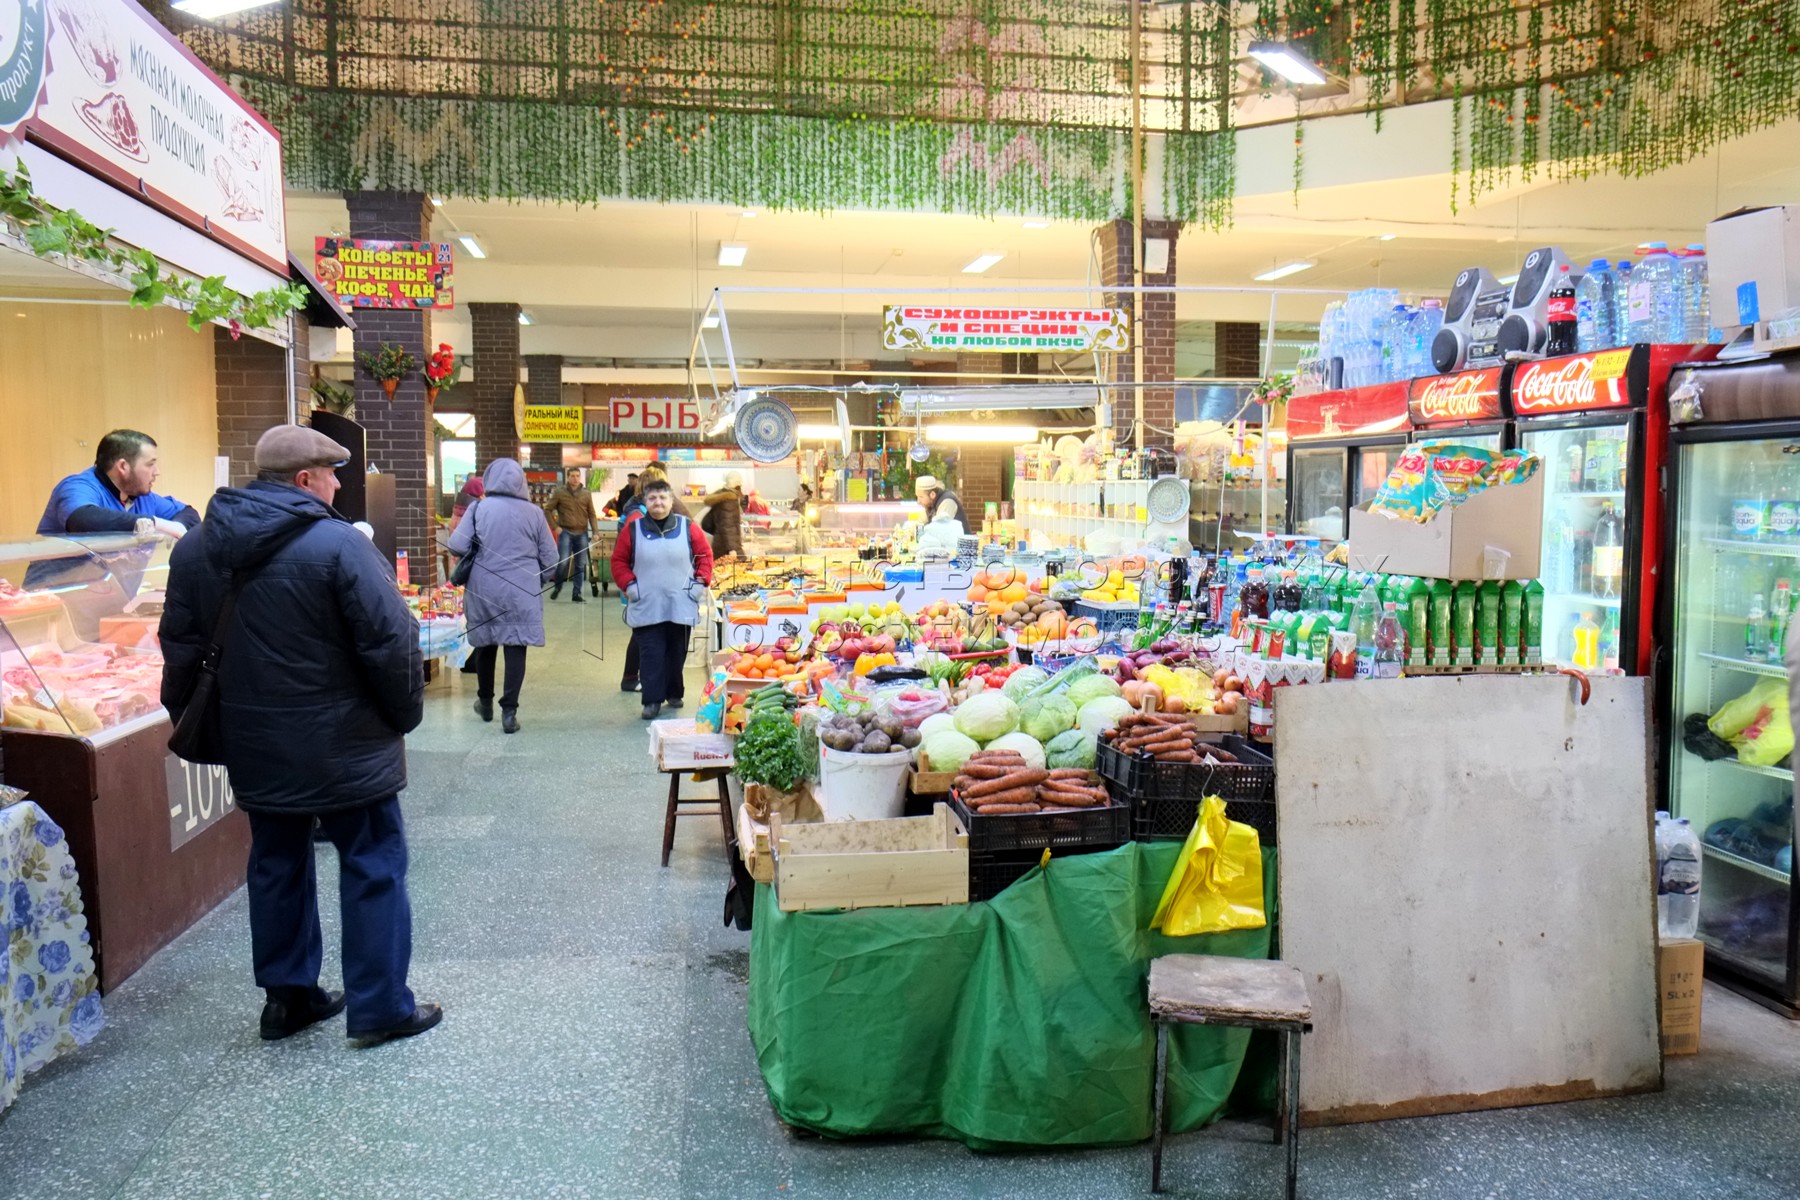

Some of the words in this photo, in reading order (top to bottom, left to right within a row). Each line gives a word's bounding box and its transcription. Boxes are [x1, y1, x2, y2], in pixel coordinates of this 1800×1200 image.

[129, 35, 169, 102] МЯСНАЯ
[170, 70, 178, 108] И
[180, 79, 225, 145] МОЛОЧНАЯ
[150, 104, 206, 177] ПРОДУКЦИЯ
[337, 247, 433, 266] КОНФЕТЫ
[437, 253, 451, 263] 21
[343, 264, 428, 282] ПЕЧЕНЬЕ
[335, 280, 394, 299] КОФЕ,
[398, 282, 436, 299] ЧАЙ
[904, 308, 1111, 322] СУХОФРУКТЫ
[940, 322, 958, 333] И
[964, 323, 1078, 336] СПЕЦИИ
[931, 336, 957, 345] НА
[1036, 337, 1085, 347] ВКУС
[1518, 357, 1596, 409] Coca-Cola
[1421, 373, 1487, 418] Coca-Cola
[558, 421, 579, 431] МАСЛО
